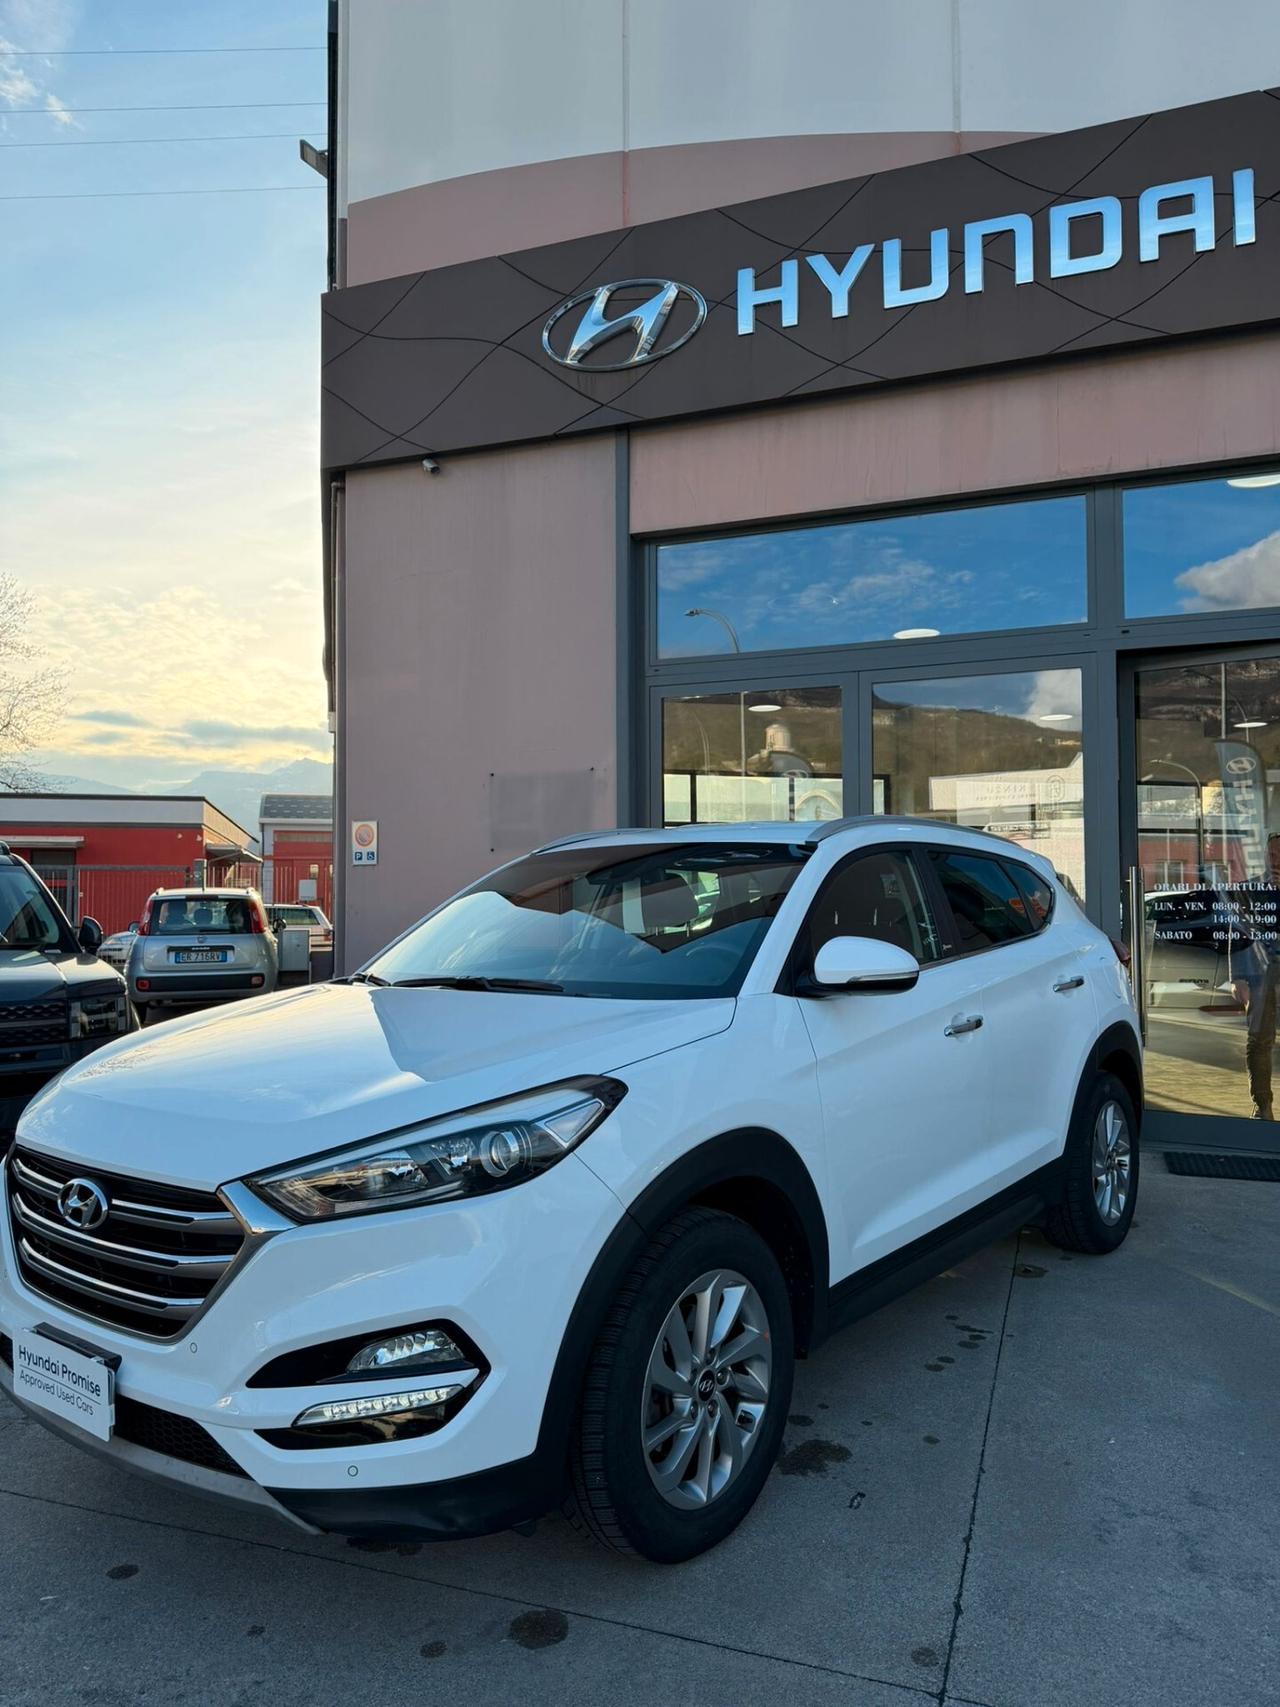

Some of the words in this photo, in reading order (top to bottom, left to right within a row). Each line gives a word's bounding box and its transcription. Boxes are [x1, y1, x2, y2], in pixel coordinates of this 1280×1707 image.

[737, 167, 1255, 335] HYUNDAI
[1154, 883, 1189, 891] ORARI
[1194, 883, 1206, 891] DI
[1209, 883, 1277, 891] APERTURA:
[1154, 902, 1176, 911] LUN.
[1185, 902, 1207, 911] VEN.
[1212, 902, 1239, 911] 08:00
[1250, 902, 1277, 911] 12:00
[1213, 915, 1239, 923] 14:00
[1250, 915, 1277, 923] 19:00
[1155, 931, 1192, 940] SABATO
[1213, 931, 1240, 940] 08:00
[1250, 931, 1277, 940] 13:00
[19, 1345, 60, 1375] Hyundai
[61, 1364, 101, 1397] Promise
[20, 1370, 55, 1395] Approved
[56, 1386, 75, 1405] Used
[76, 1396, 94, 1416] Cars
